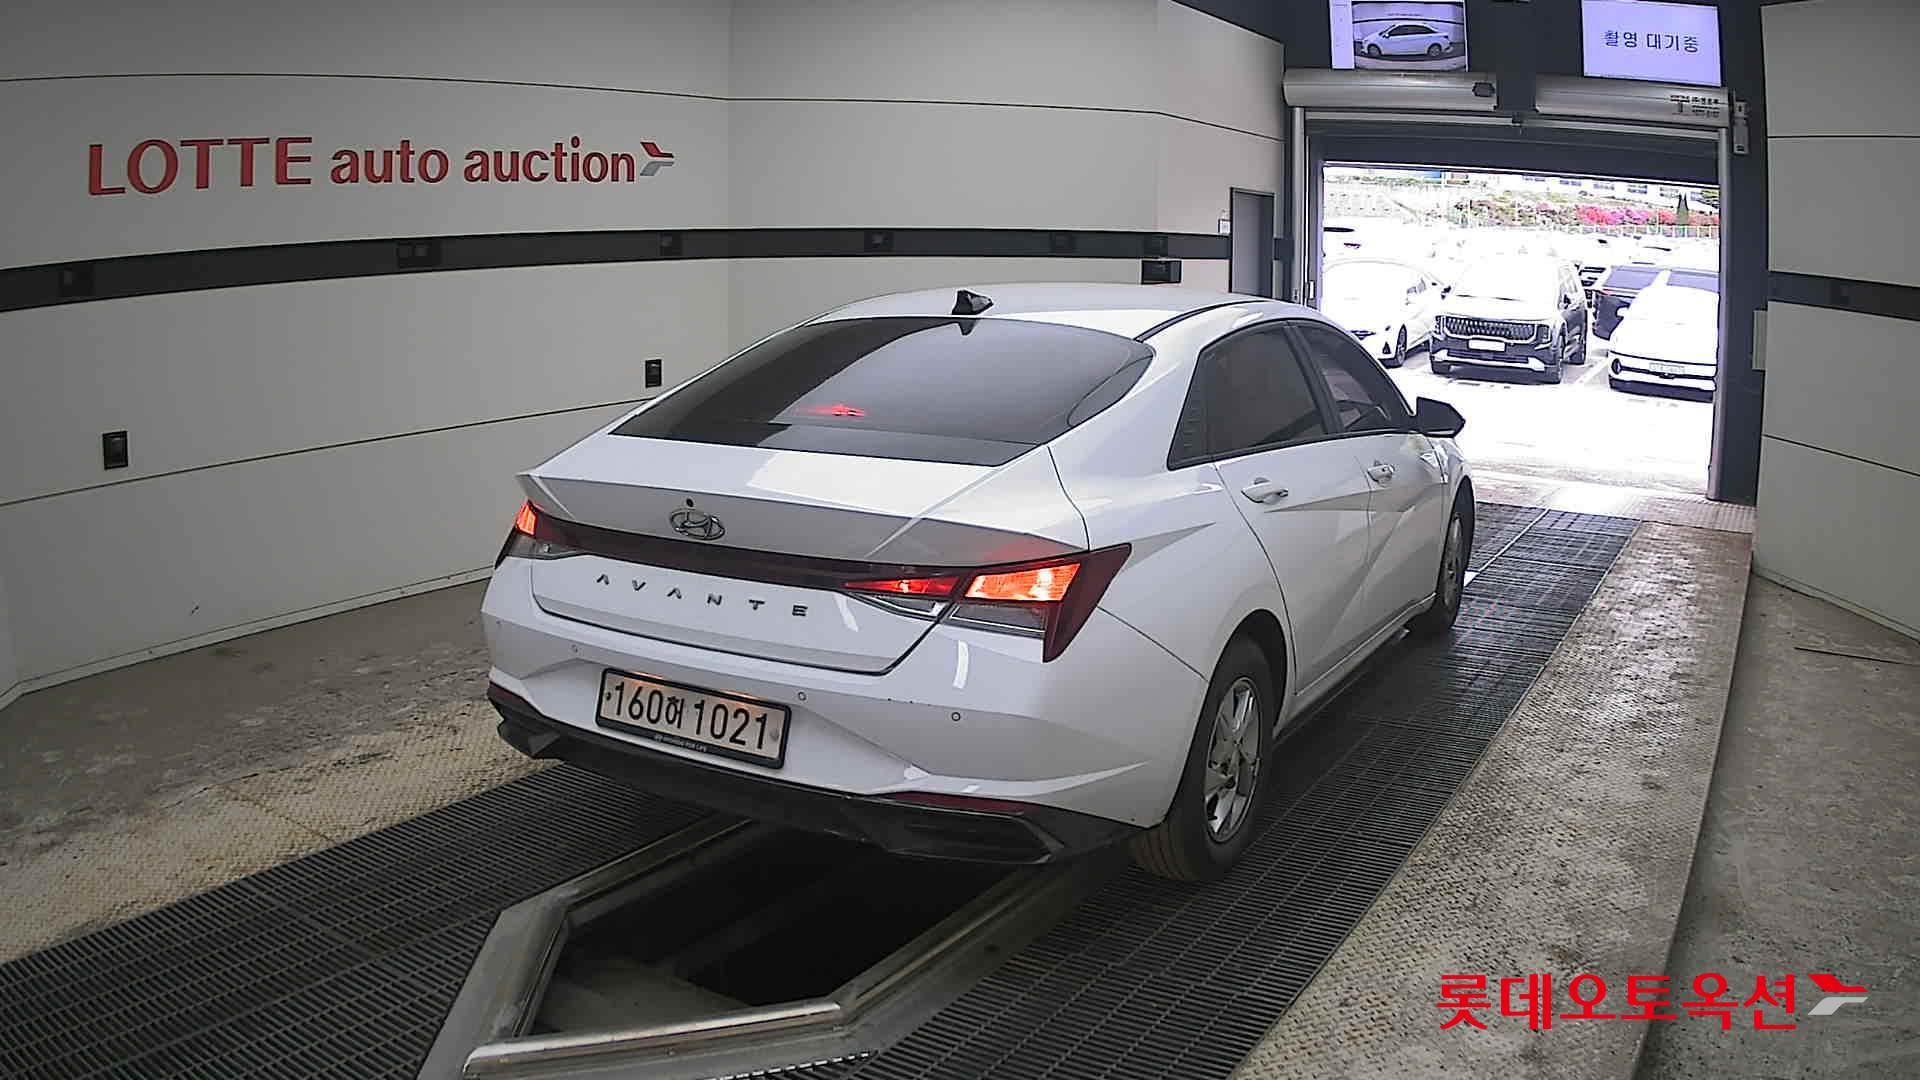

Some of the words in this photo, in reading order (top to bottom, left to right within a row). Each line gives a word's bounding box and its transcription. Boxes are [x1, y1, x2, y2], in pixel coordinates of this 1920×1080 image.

[1645, 33, 1699, 53] 대기중
[89, 137, 312, 195] LOTTE
[330, 139, 449, 184] auto
[463, 136, 635, 183] auction
[596, 574, 808, 617] AVANTE
